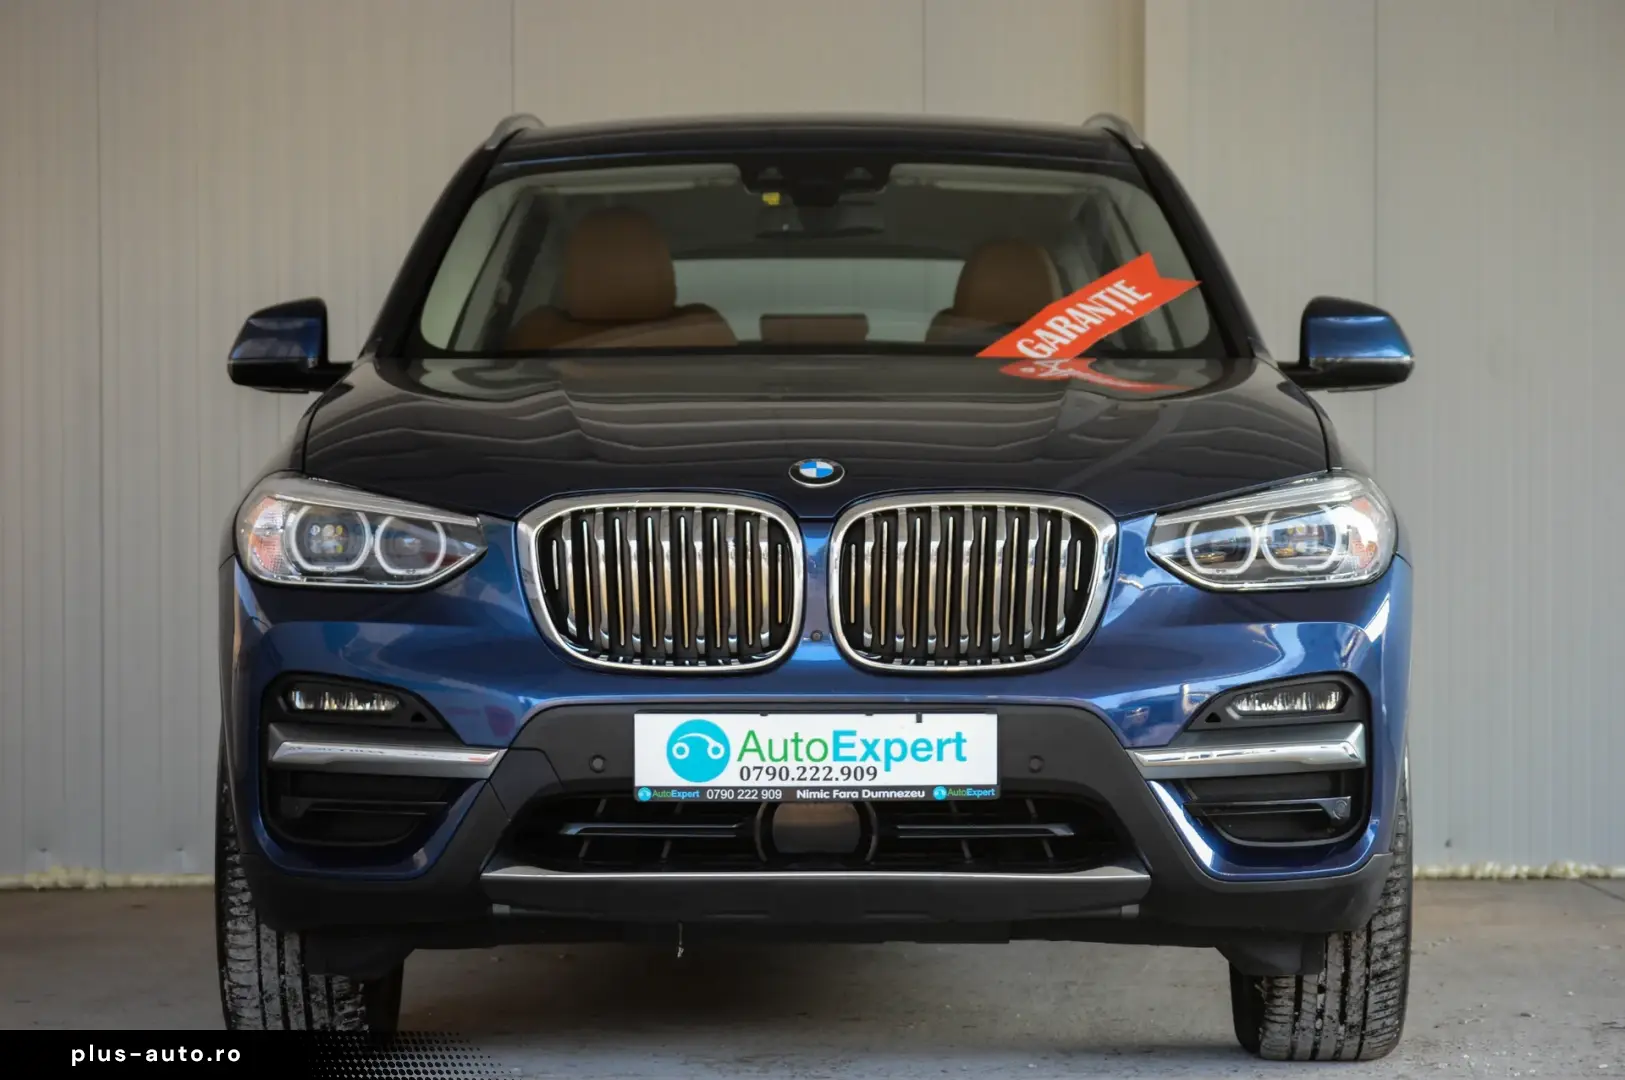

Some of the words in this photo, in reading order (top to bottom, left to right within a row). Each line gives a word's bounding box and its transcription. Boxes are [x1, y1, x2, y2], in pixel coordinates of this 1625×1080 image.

[737, 730, 967, 772] AutoExpert
[739, 765, 878, 782] 0790.222.909
[652, 789, 700, 799] AutoExpert
[706, 788, 735, 800] 0790
[737, 788, 759, 800] 222
[761, 788, 782, 800] 909
[796, 789, 830, 799] Nimic
[832, 789, 859, 799] Fara
[861, 789, 926, 799] Dumnezeu
[947, 788, 996, 798] AutoExpert
